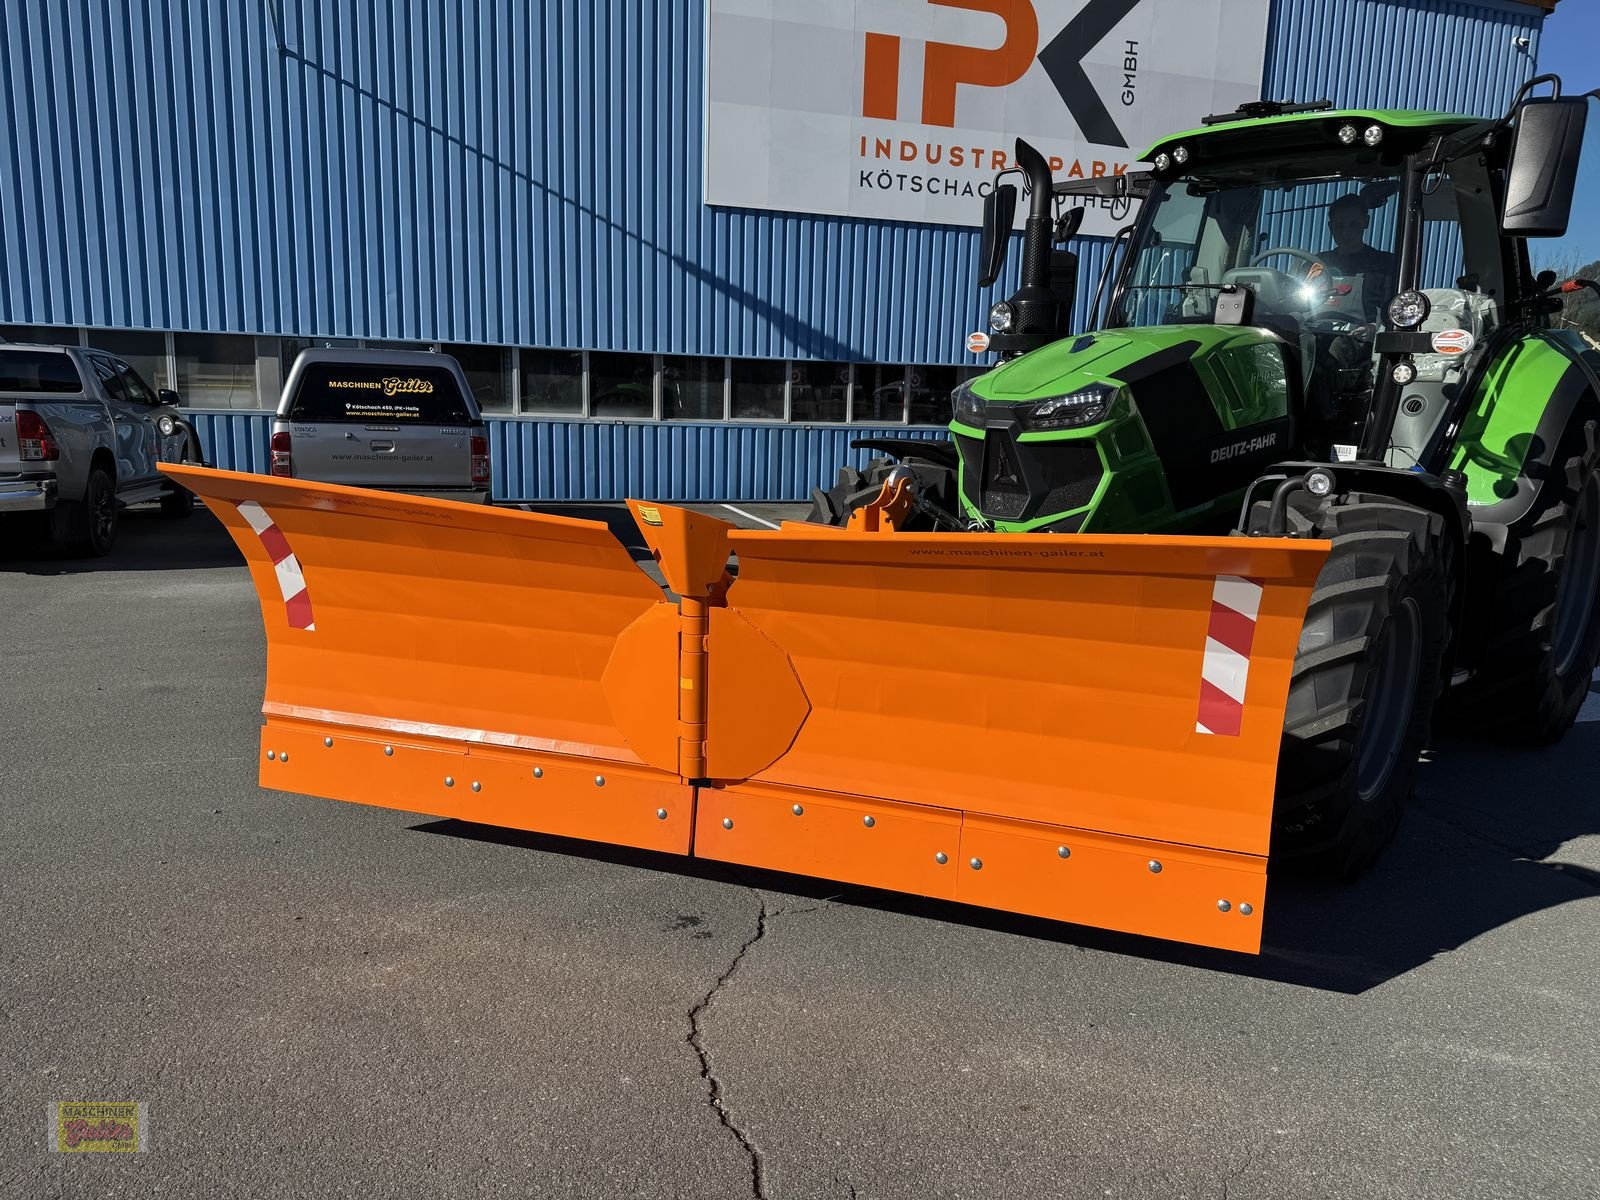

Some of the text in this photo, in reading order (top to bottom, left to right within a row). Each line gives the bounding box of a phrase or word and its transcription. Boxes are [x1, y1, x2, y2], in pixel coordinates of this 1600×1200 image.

[1121, 40, 1139, 106] GMBH
[860, 136, 1128, 178] INDUSTRPARK
[328, 377, 433, 396] MASCHINEN Gailer
[331, 454, 434, 463] www.maschinen-gailer.at
[1210, 433, 1277, 464] DEUTZ-FAHR
[908, 549, 1105, 558] www.maschinen-gailer.at
